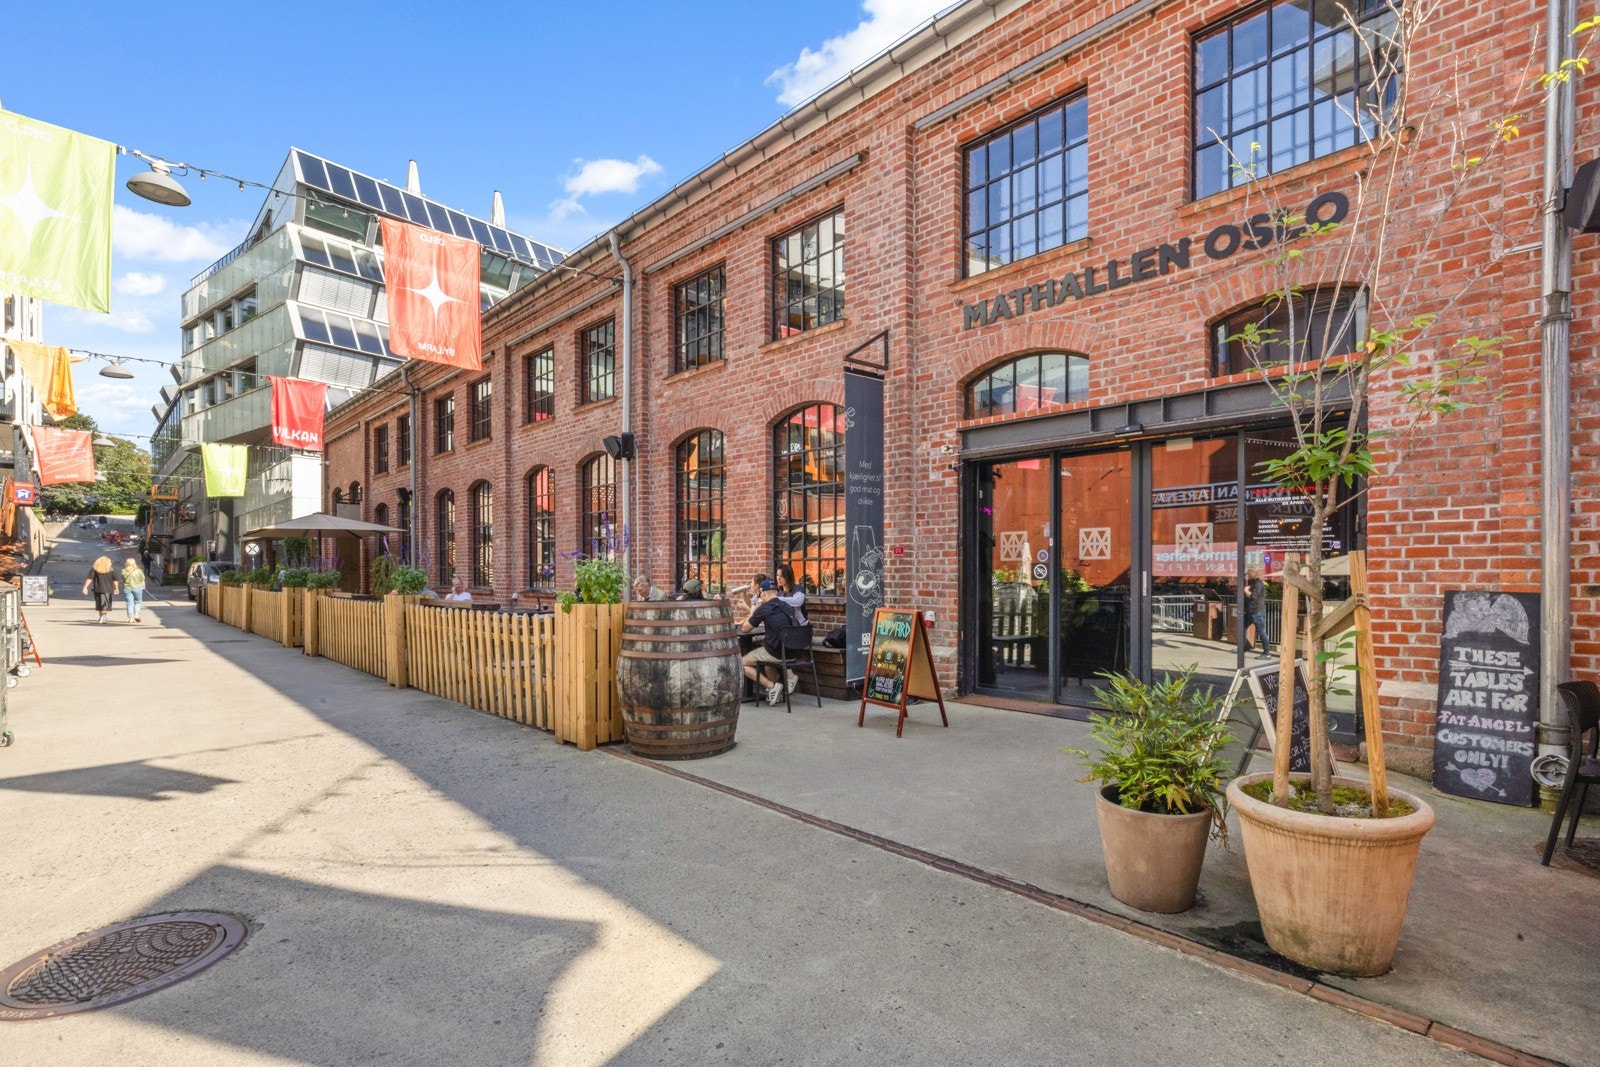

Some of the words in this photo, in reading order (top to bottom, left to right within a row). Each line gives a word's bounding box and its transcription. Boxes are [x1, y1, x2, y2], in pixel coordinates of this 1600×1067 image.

[963, 237, 1191, 331] MATHALLEN
[1204, 191, 1349, 260] OSLO
[1454, 647, 1520, 667] THESE
[1450, 671, 1525, 691] TABLES
[1444, 689, 1487, 708] ARE
[1467, 714, 1531, 733] ANGEL
[1437, 728, 1534, 756] CUSTOMERS
[1454, 750, 1510, 769] ONLY!
